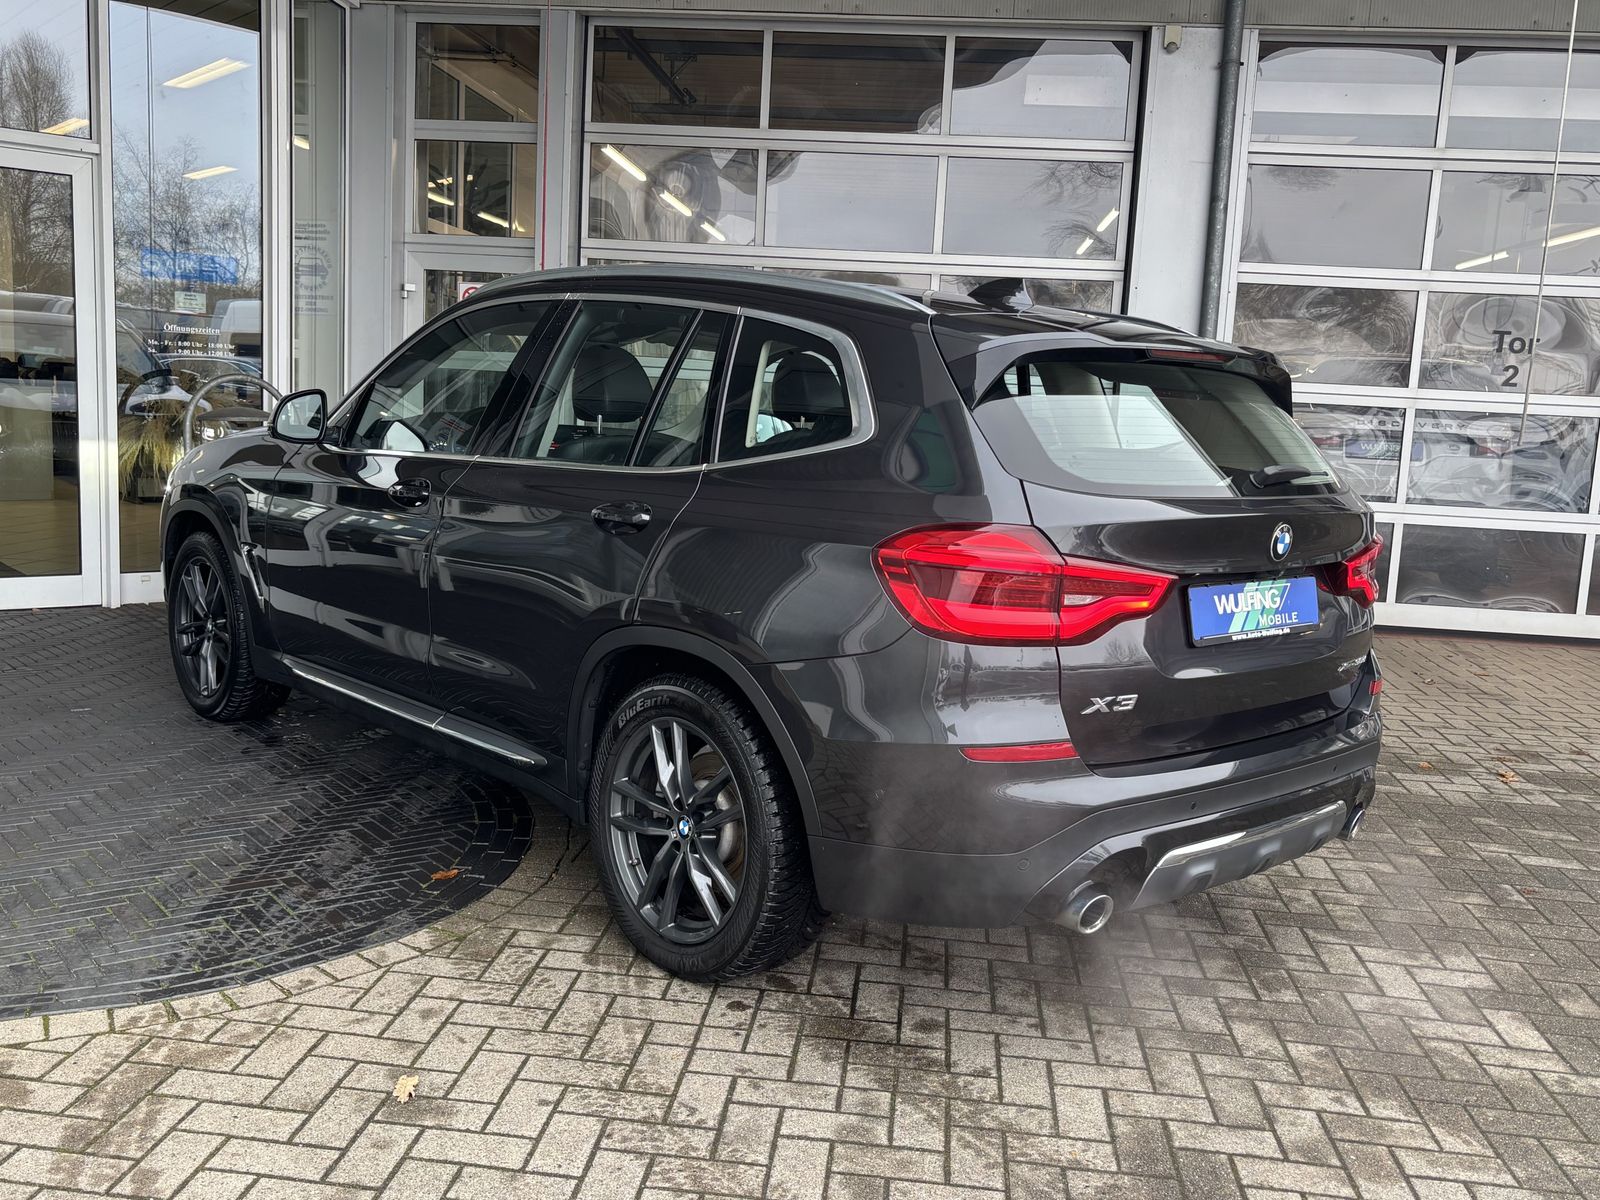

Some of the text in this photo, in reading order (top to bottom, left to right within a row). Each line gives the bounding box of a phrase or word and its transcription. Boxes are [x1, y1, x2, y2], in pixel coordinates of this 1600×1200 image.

[163, 322, 221, 335] Öffnungszeiten
[1492, 330, 1541, 354] Tor
[1501, 365, 1520, 387] 2
[1357, 419, 1468, 430] DISCVERY
[1213, 589, 1281, 615] WULFING
[1258, 611, 1299, 627] MOBILE
[617, 694, 670, 729] BluEarth
[1080, 694, 1138, 715] X3
